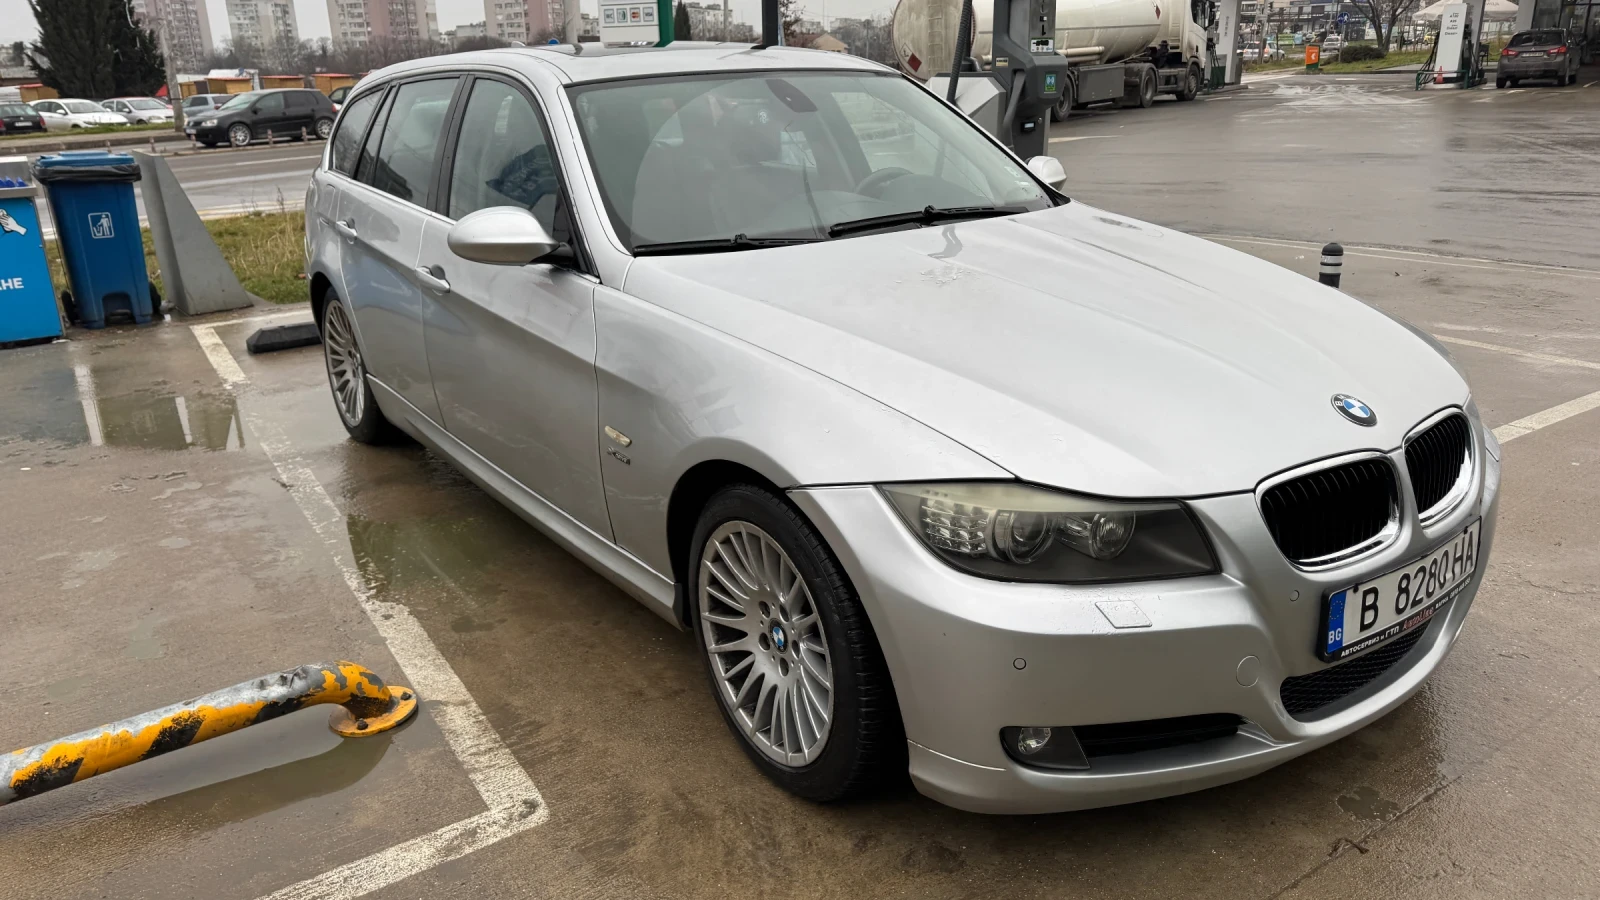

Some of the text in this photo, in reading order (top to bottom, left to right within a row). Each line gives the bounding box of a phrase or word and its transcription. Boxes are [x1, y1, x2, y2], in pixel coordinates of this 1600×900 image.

[0, 277, 25, 291] НЕ
[1359, 586, 1379, 633] B
[1395, 549, 1449, 615] 8280
[1451, 531, 1474, 582] HA
[1328, 627, 1342, 645] BG
[1341, 636, 1380, 658] АВТОСЕРВИЗ
[1385, 625, 1400, 638] ГТП
